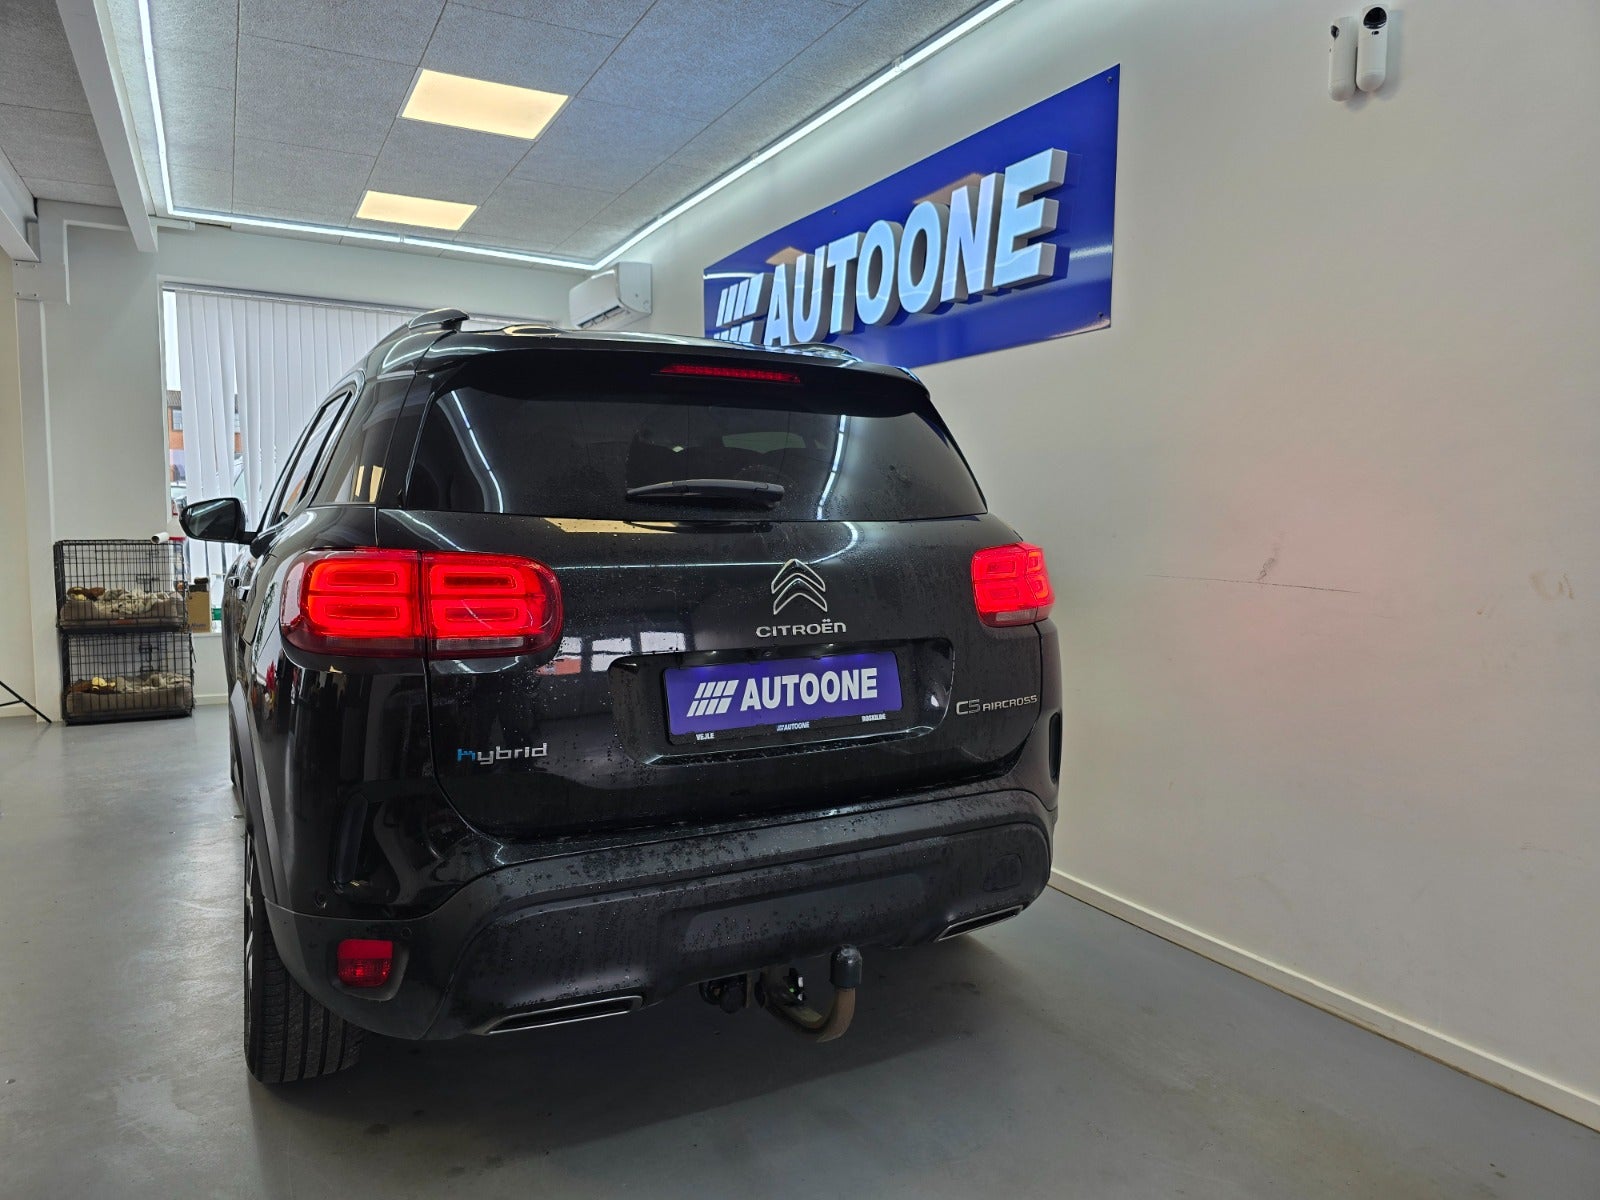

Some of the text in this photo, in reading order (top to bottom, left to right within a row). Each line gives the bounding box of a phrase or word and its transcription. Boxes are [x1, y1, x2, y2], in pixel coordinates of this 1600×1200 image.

[763, 147, 1068, 347] AUTOONE
[739, 667, 878, 712] AUTOONE
[956, 694, 1038, 715] C5 AIRCROSS
[695, 732, 715, 741] VEJLE
[783, 721, 810, 731] AUTOONE
[457, 742, 548, 765] hybrid
